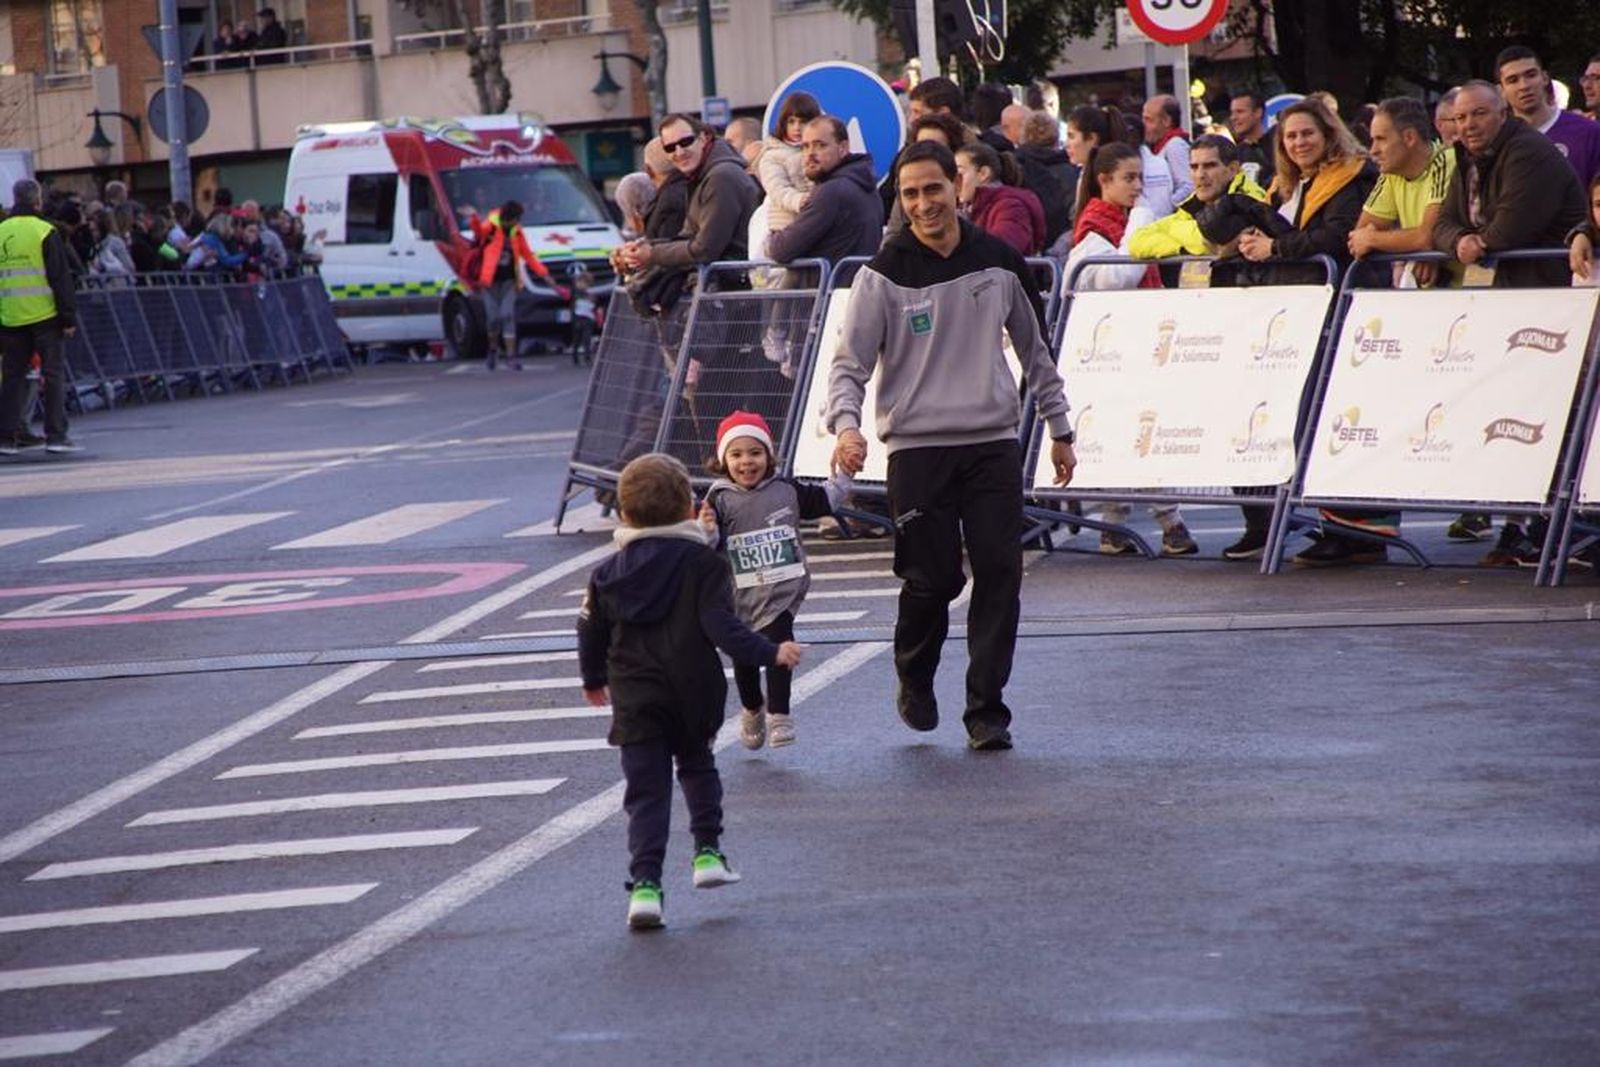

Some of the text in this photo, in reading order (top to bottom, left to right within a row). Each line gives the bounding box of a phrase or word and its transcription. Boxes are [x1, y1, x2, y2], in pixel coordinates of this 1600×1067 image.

[1360, 339, 1402, 352] SETEL
[1338, 428, 1379, 441] SETEL
[737, 542, 786, 570] 6302
